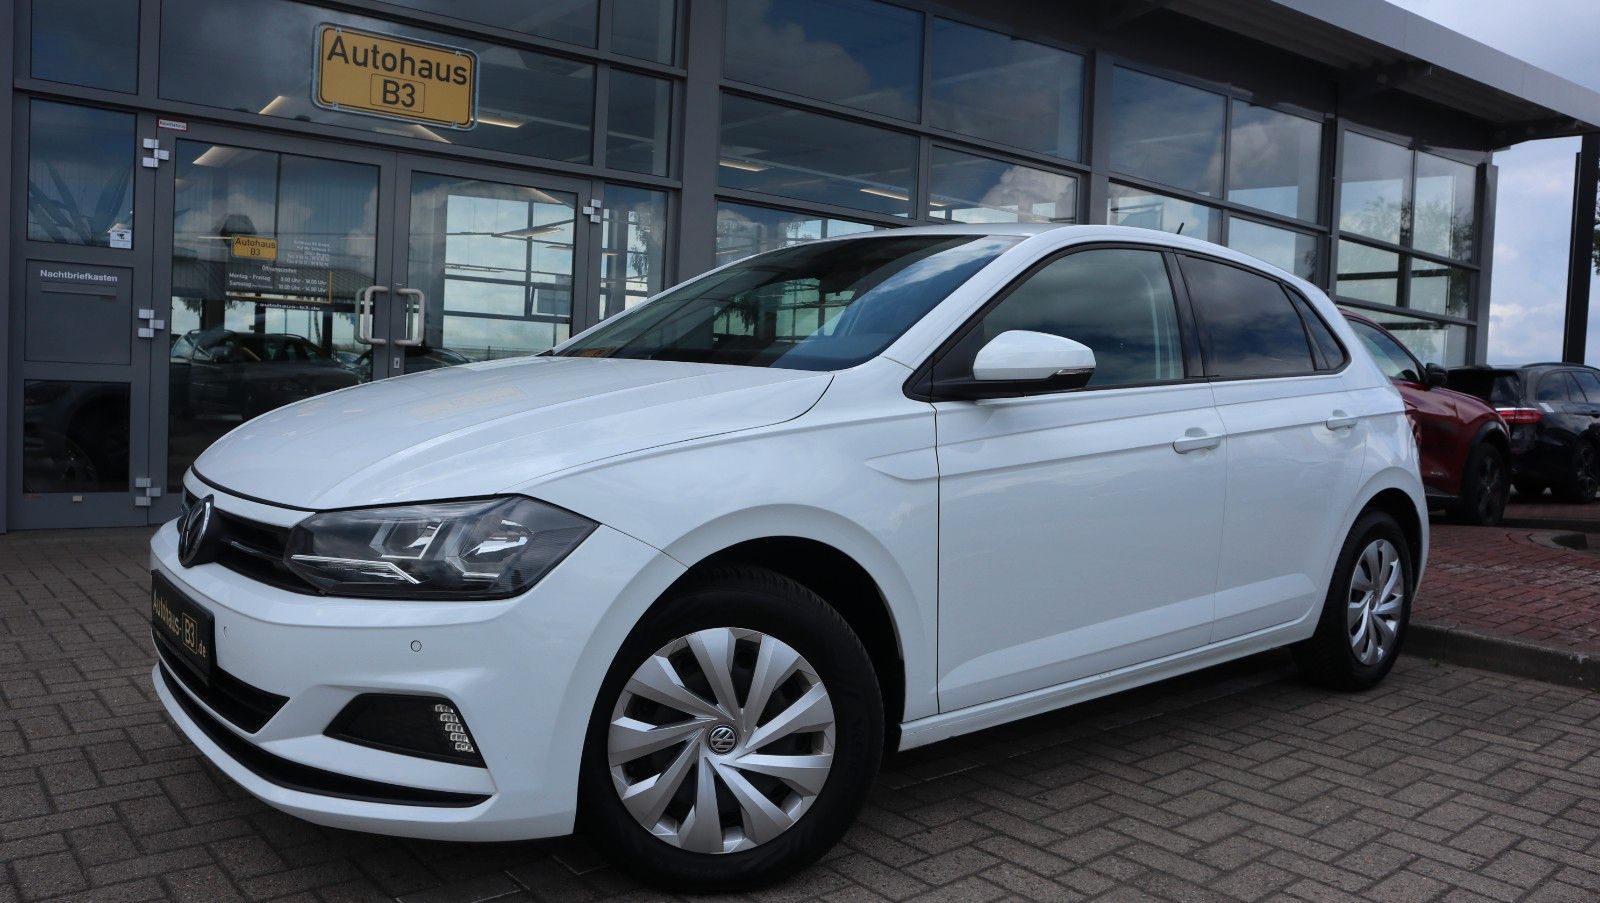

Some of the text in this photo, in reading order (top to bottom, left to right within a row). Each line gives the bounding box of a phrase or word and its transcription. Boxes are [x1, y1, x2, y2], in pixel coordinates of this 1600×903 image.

[327, 35, 467, 86] Autohaus
[382, 79, 416, 108] B3
[235, 237, 276, 248] Autohaus
[40, 269, 118, 282] Nachtbriefkasten
[228, 272, 248, 280] Montag
[229, 280, 251, 288] Samstag
